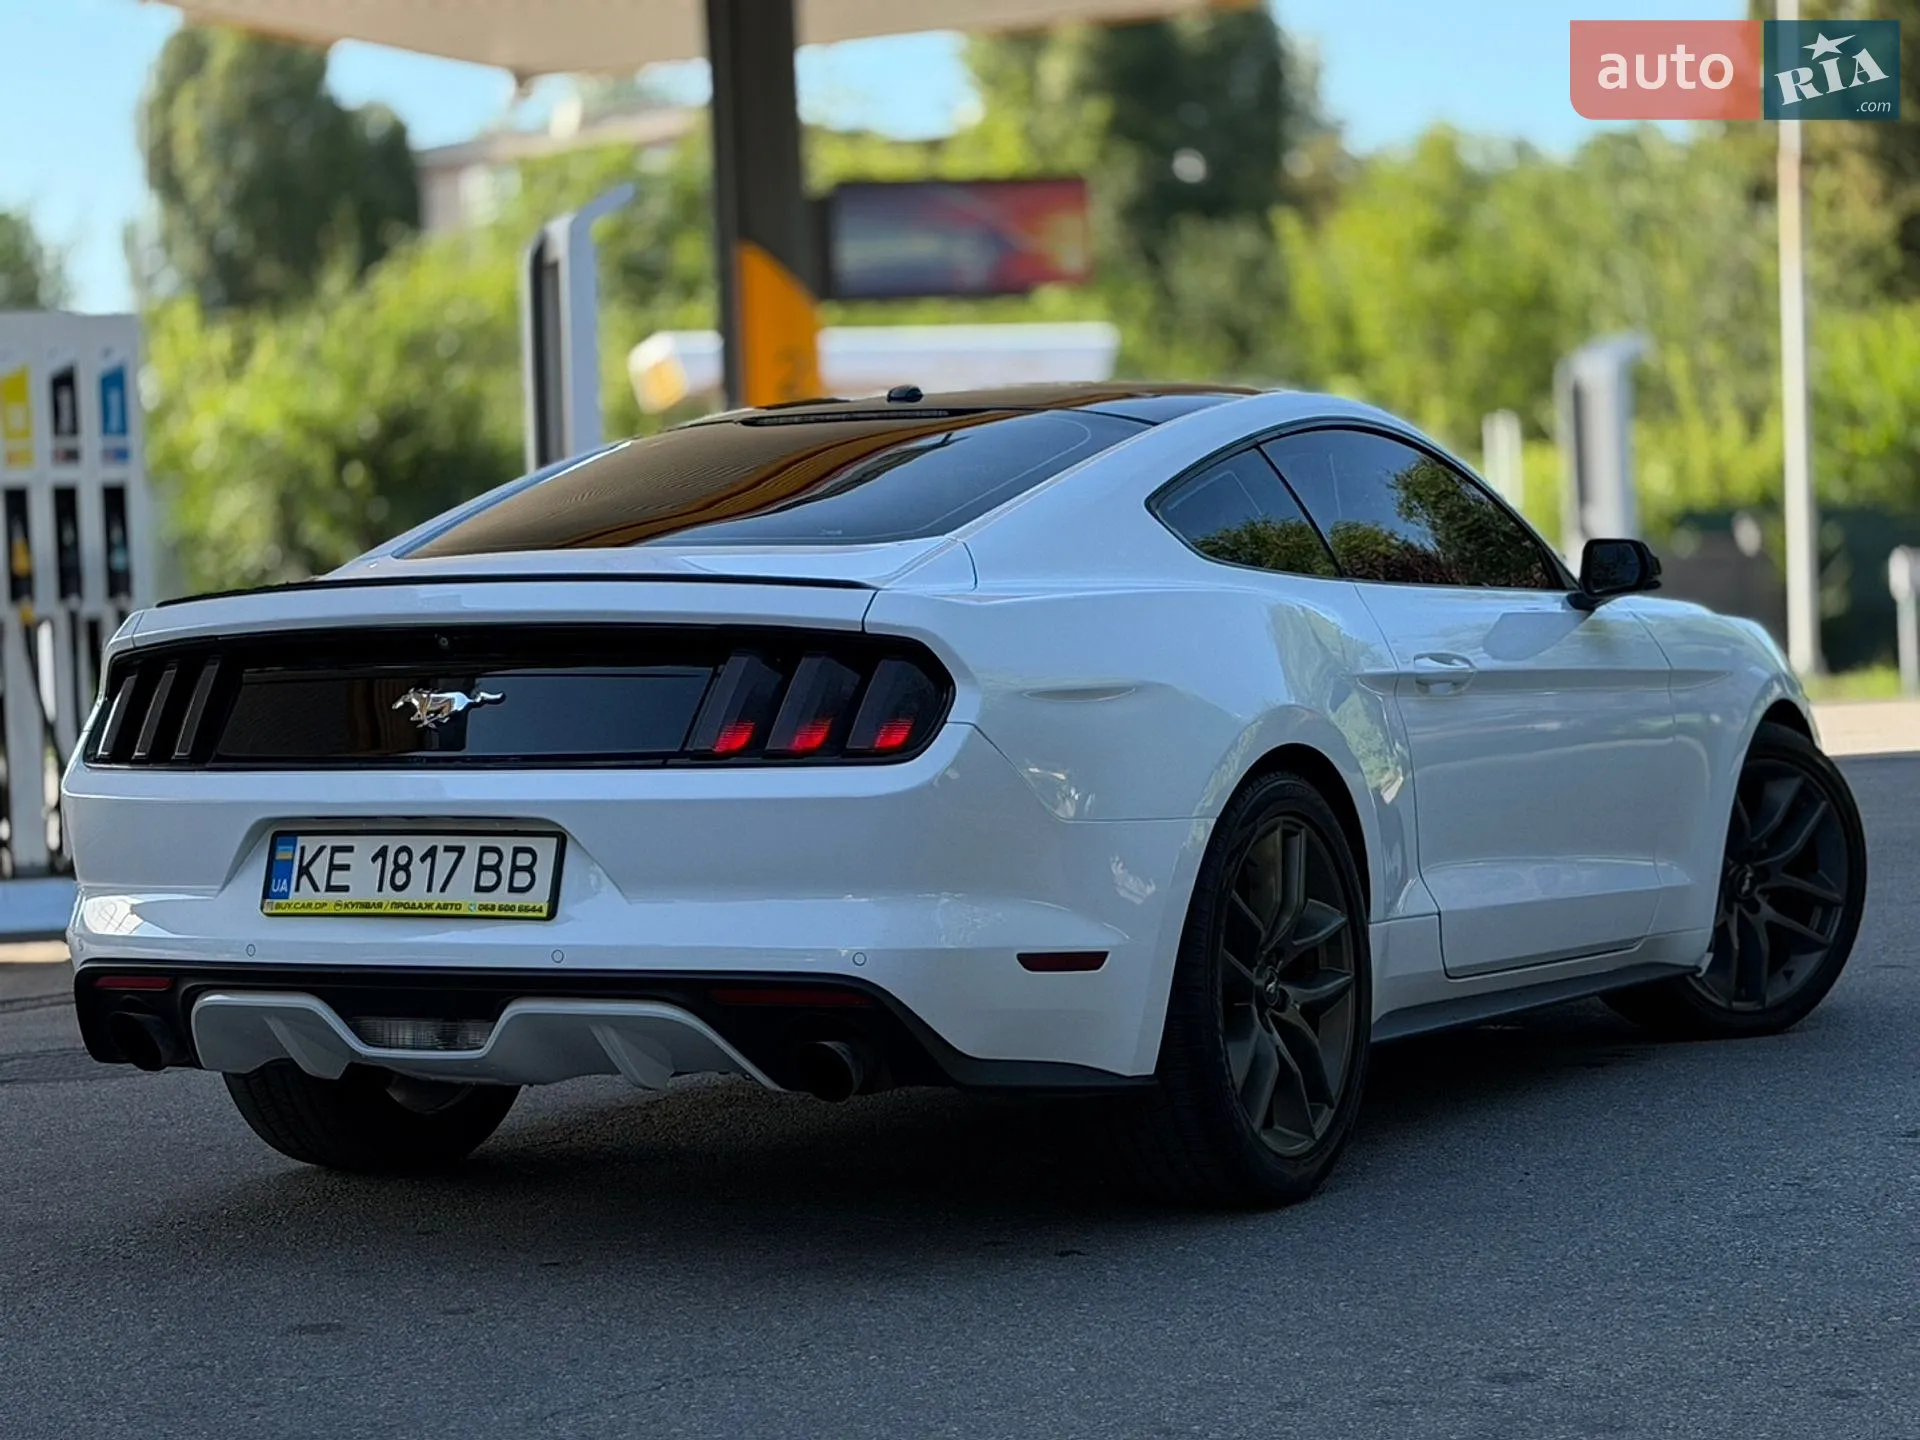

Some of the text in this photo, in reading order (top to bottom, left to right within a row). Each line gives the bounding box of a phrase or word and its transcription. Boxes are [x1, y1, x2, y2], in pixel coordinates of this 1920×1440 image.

[294, 844, 538, 893] KE 1817 BB
[271, 878, 289, 893] UA
[390, 902, 434, 911] ПРОДАЖ
[434, 902, 463, 911] АВТО
